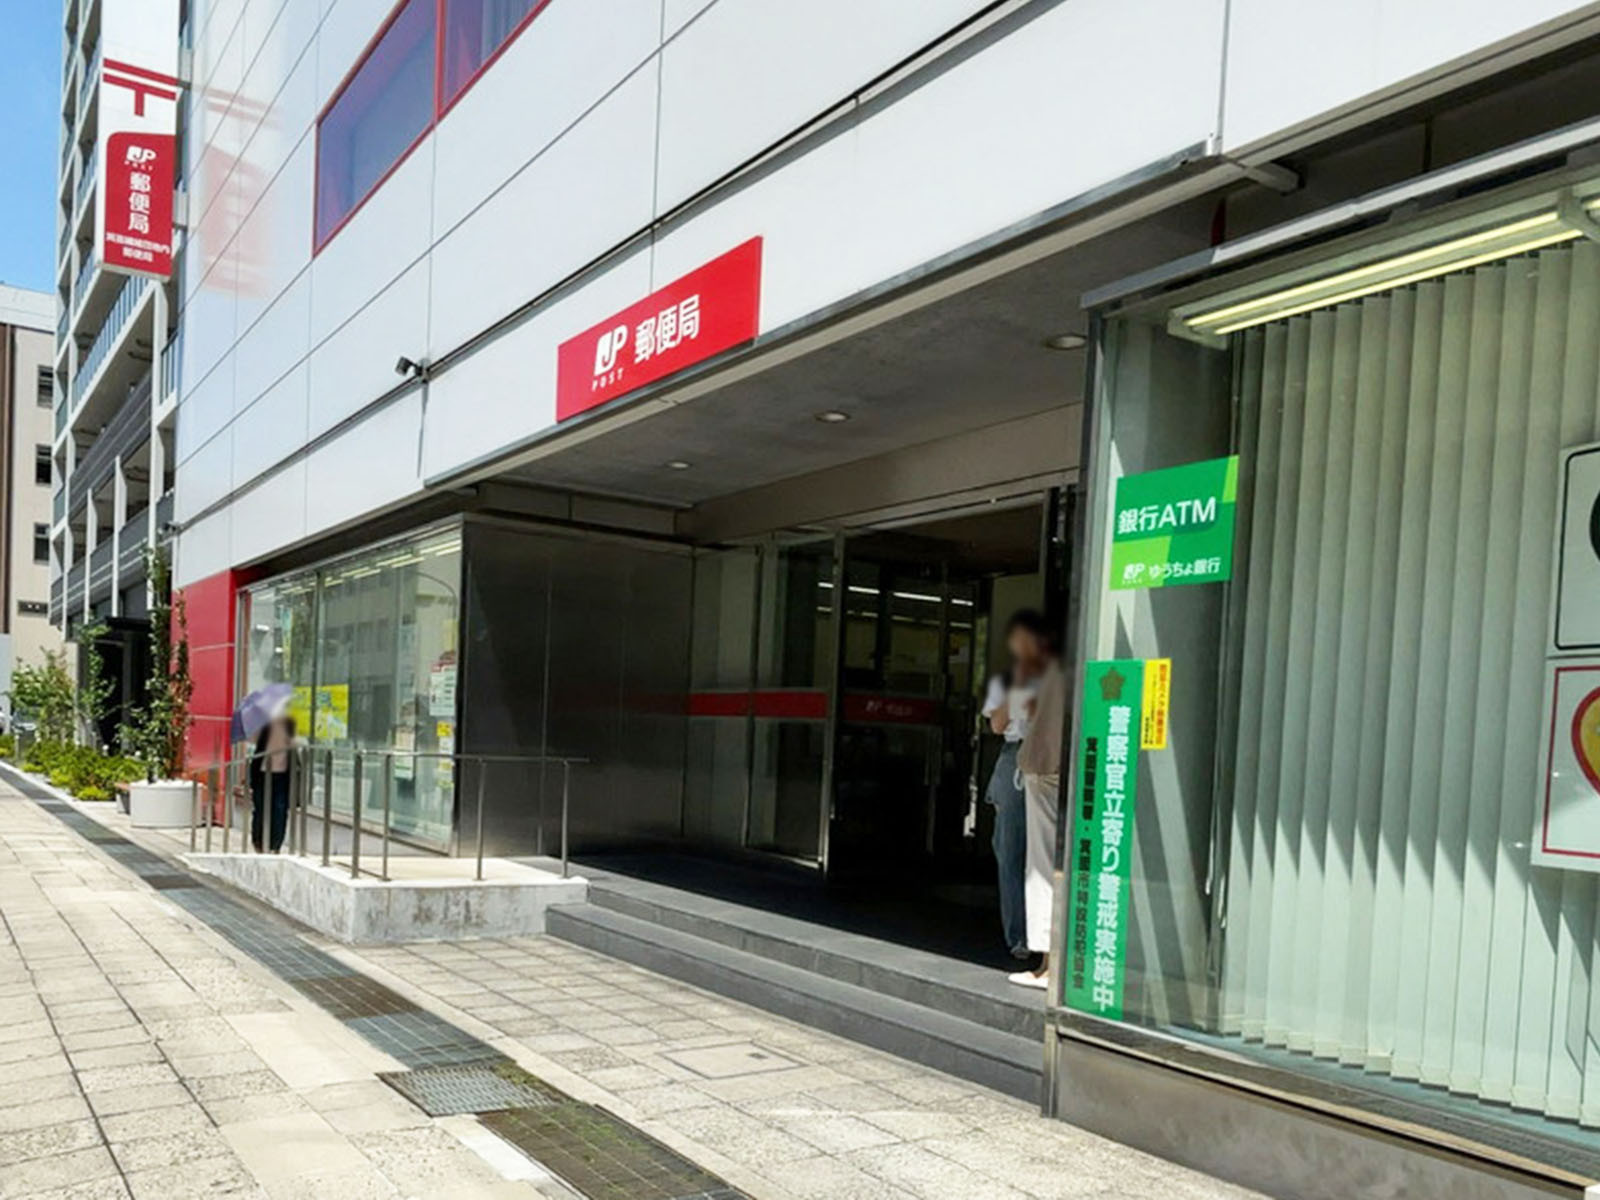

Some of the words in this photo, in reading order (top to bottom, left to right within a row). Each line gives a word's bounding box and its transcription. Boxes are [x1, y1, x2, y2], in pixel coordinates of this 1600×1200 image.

[128, 171, 151, 235] 郵便局
[593, 325, 628, 377] JP
[634, 294, 700, 364] 郵便局
[592, 368, 624, 392] POST
[1118, 496, 1216, 534] 銀行ATM
[1149, 557, 1221, 580] ゆうちょ銀行
[1093, 706, 1131, 1011] 警察官立寄り警戒実施中
